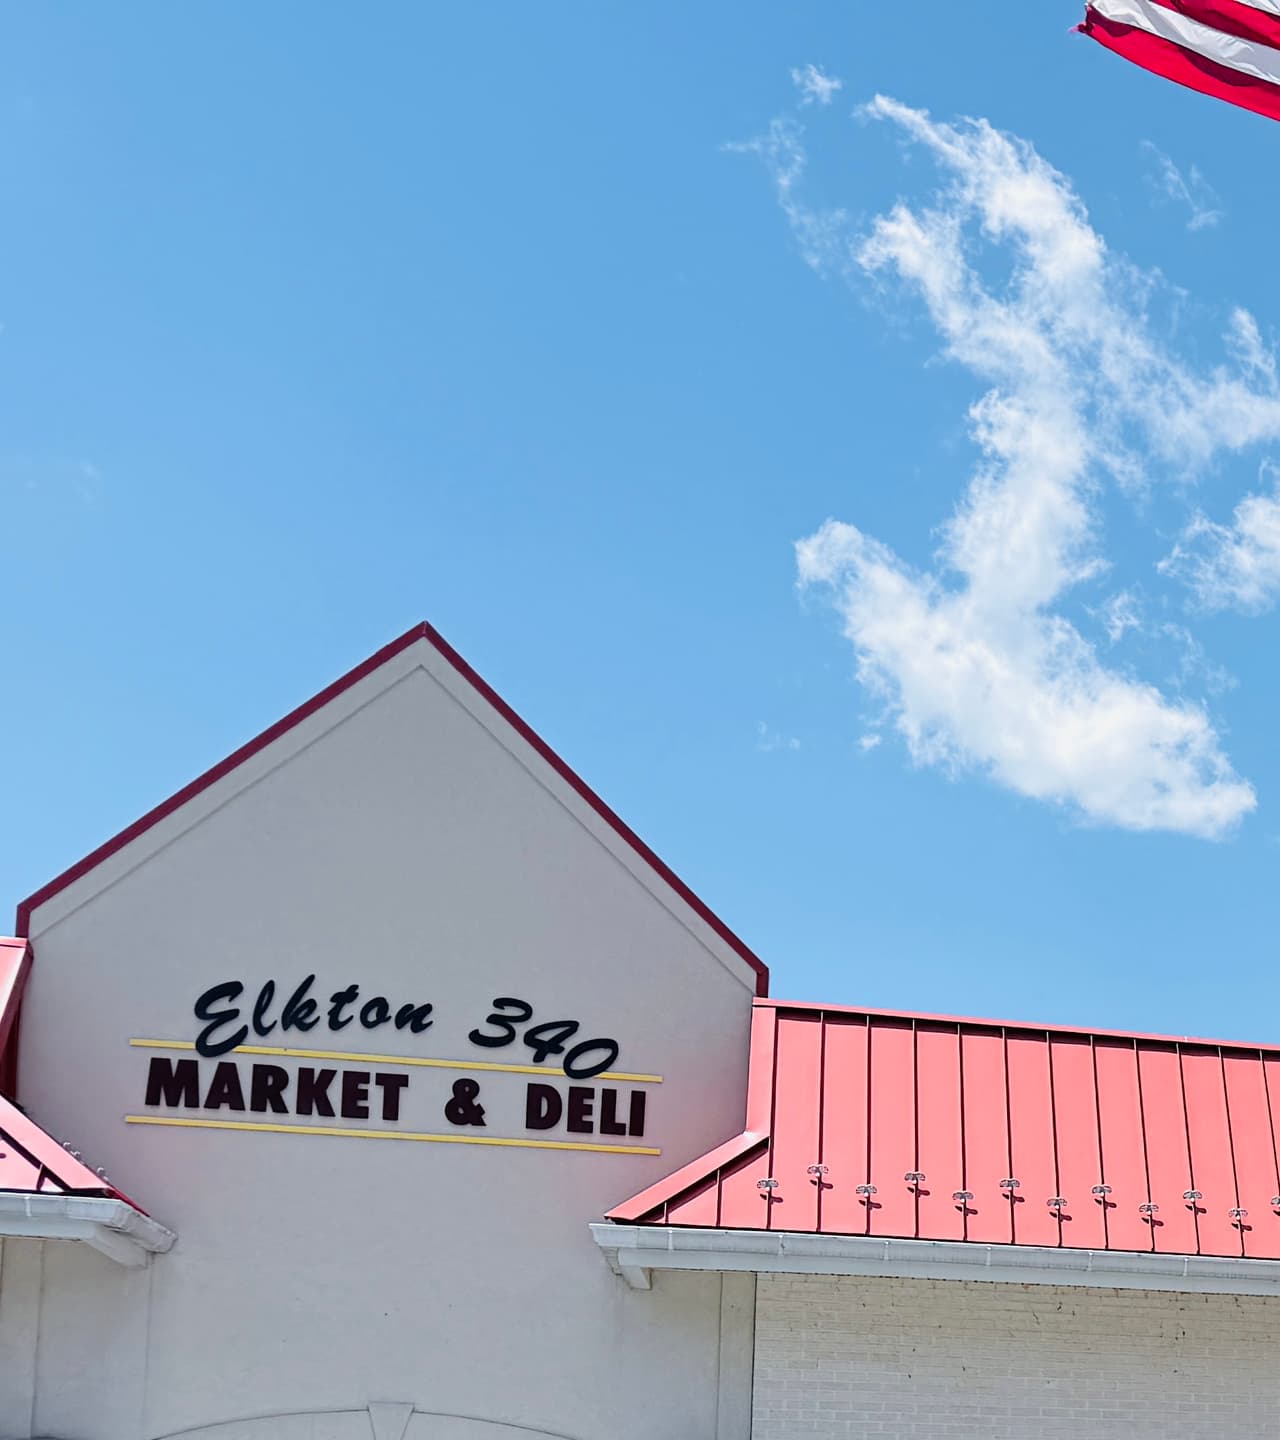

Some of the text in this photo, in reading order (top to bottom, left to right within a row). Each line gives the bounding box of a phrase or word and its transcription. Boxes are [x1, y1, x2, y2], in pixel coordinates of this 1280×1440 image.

[194, 974, 619, 1079] Elkton 340
[145, 1057, 647, 1137] MARKET & DELI
